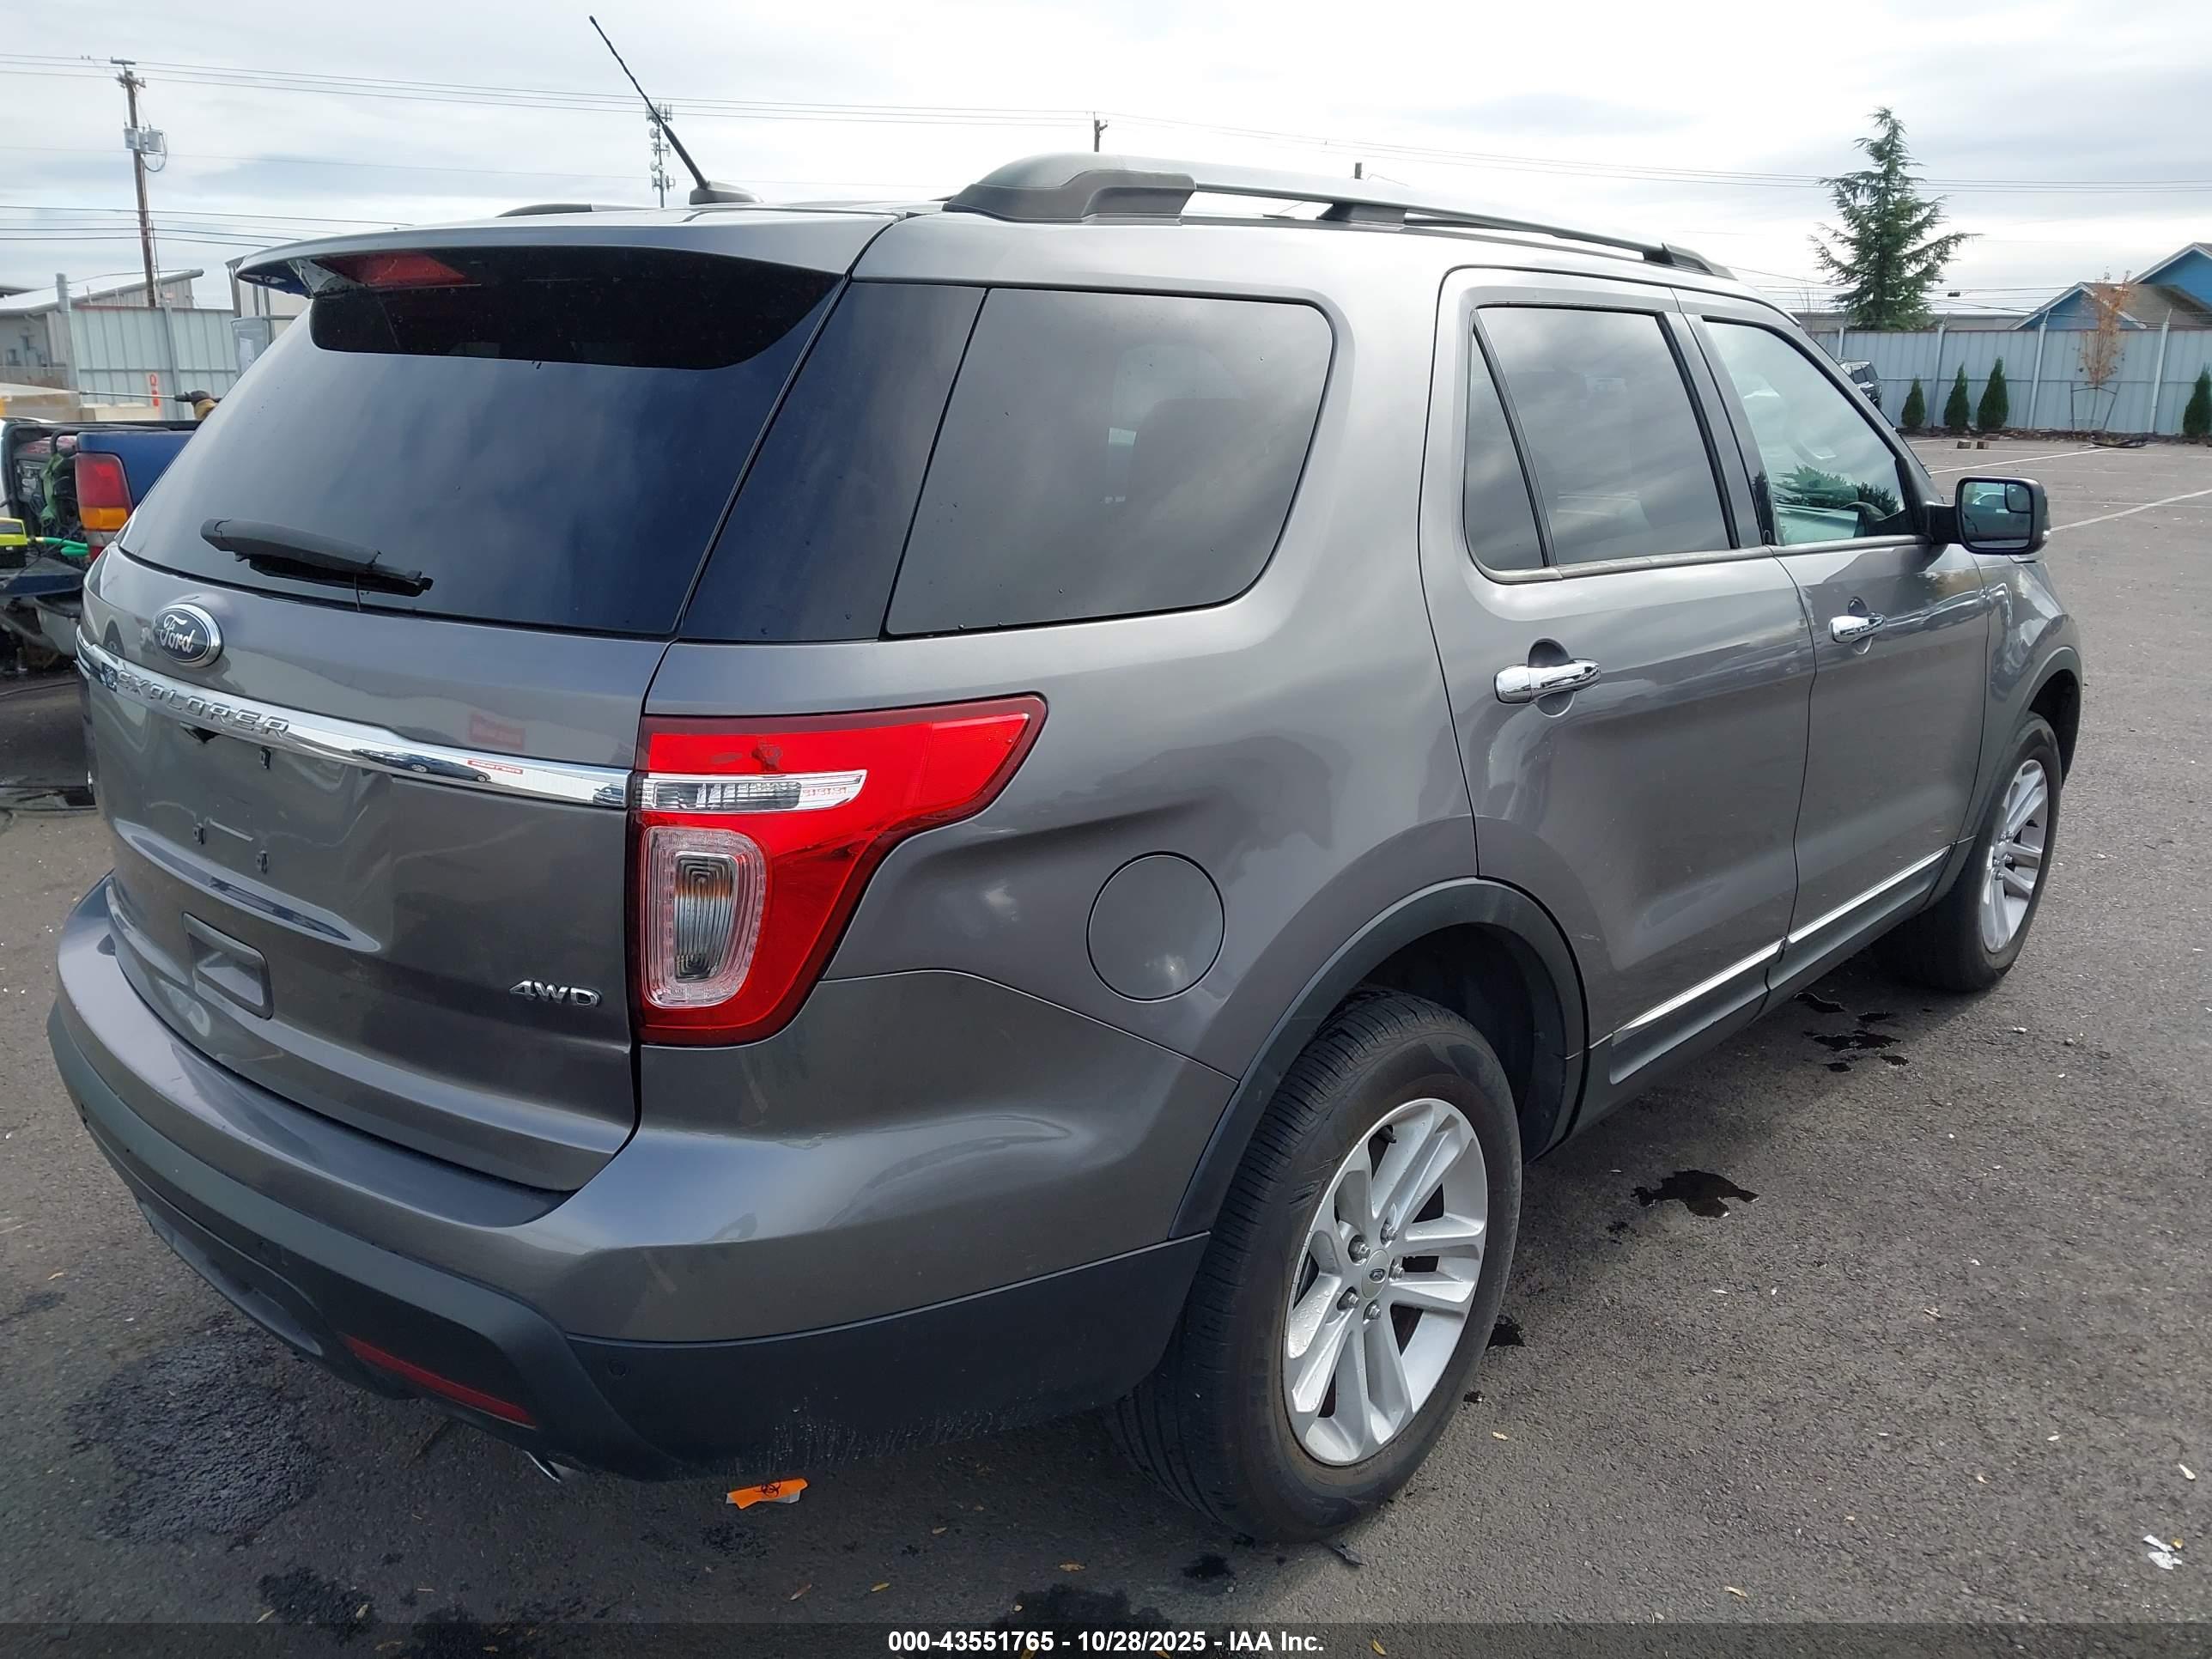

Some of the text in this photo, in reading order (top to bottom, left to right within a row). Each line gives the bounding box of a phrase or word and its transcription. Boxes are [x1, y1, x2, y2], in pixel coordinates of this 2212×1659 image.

[158, 613, 197, 653] Ford
[118, 668, 290, 738] EXPLORER
[509, 980, 600, 1006] 4WD
